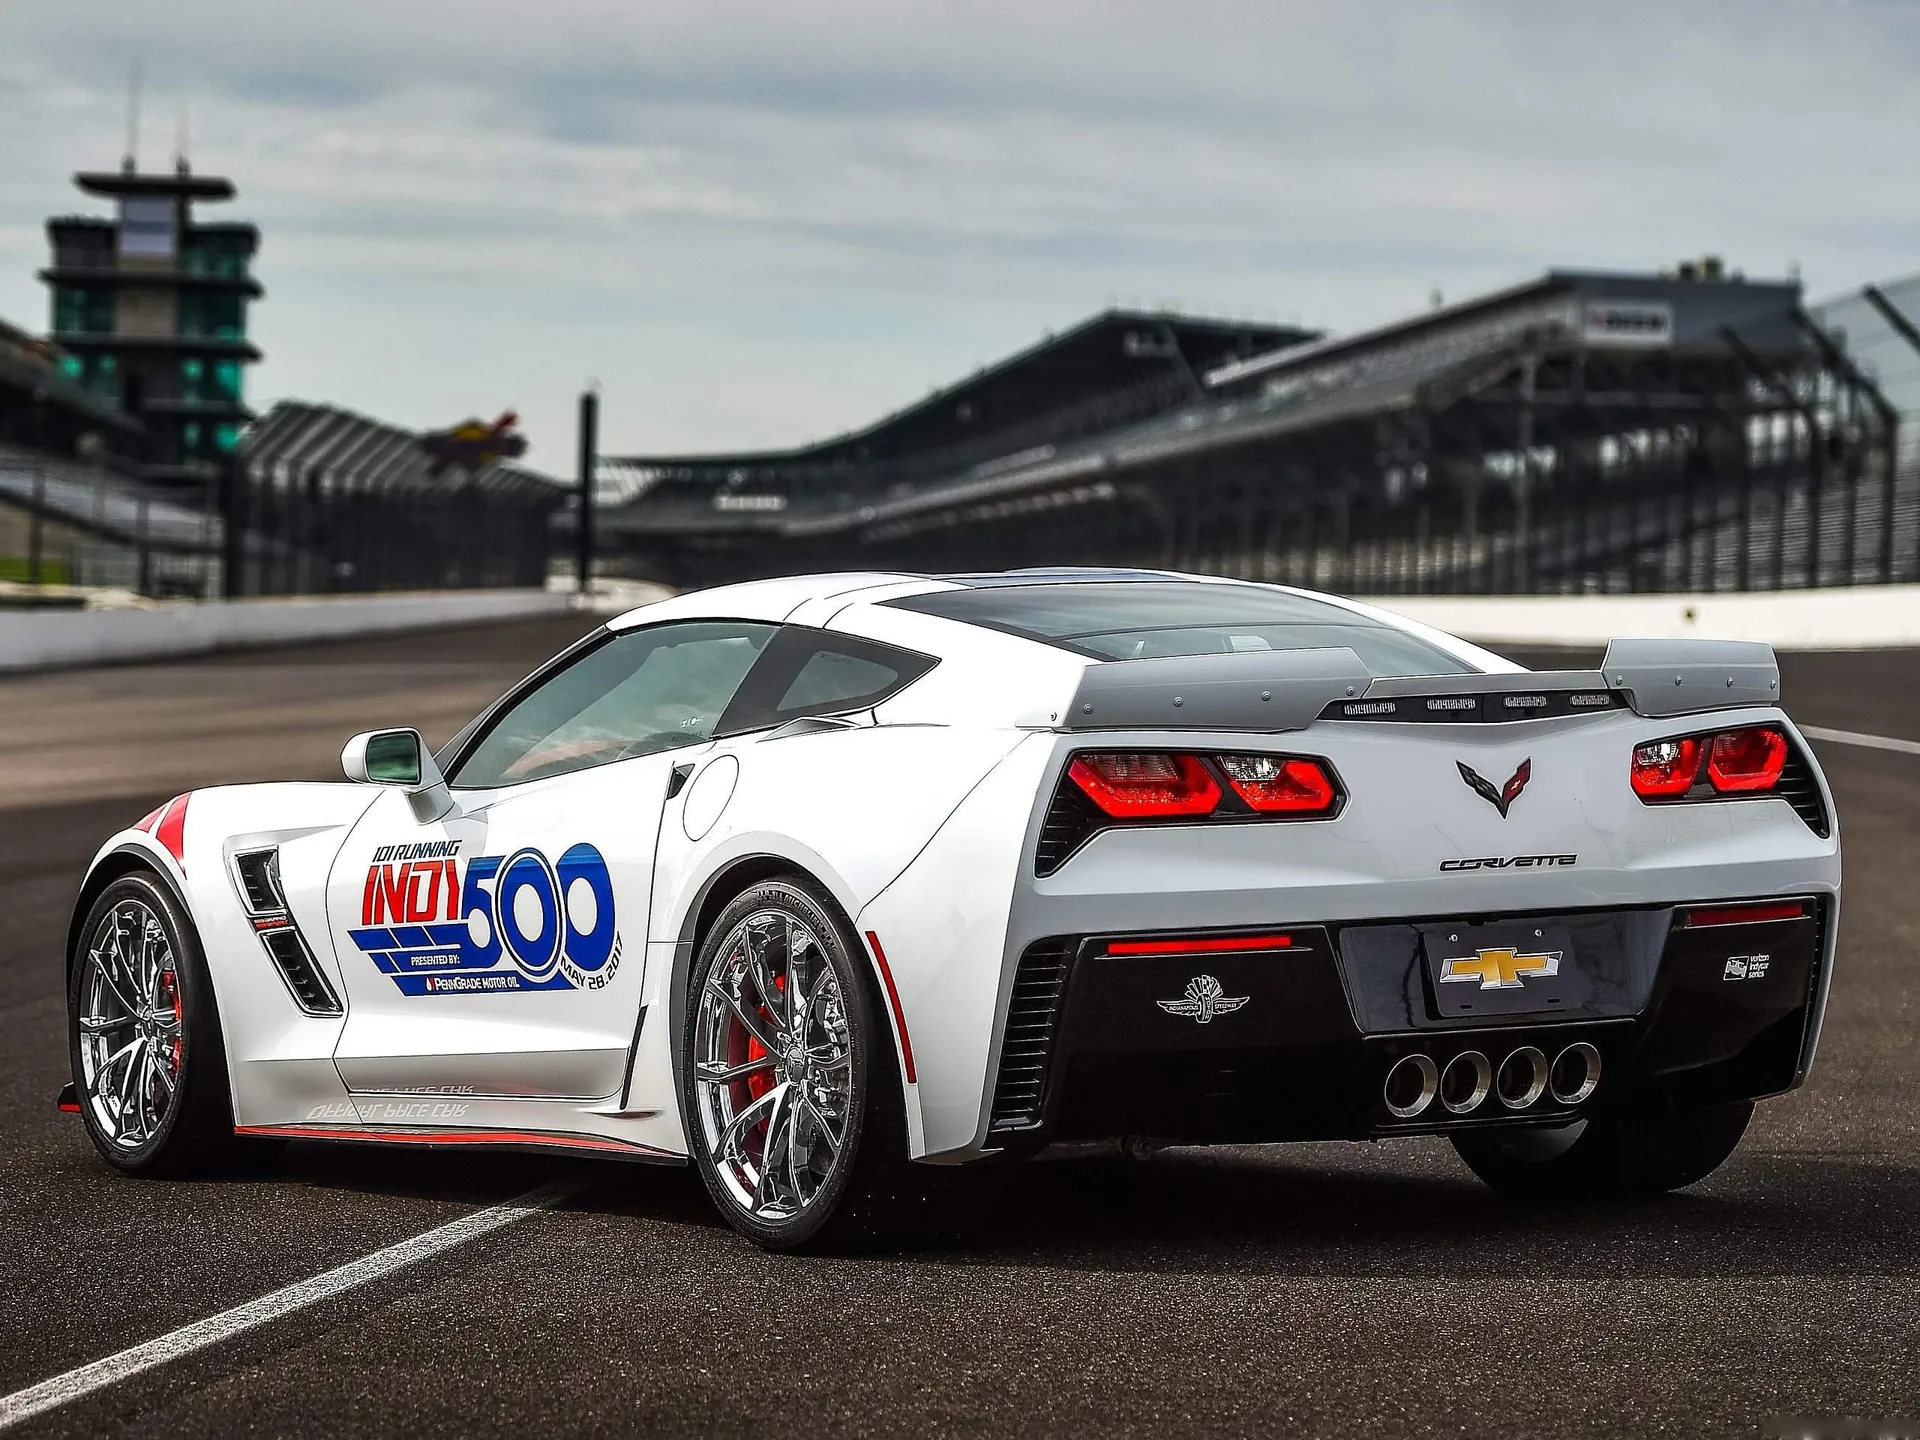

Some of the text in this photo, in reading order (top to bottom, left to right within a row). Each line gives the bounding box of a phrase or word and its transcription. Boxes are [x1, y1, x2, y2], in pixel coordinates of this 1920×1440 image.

[392, 839, 463, 862] RUNNING
[1439, 854, 1577, 872] CORVETTE
[362, 842, 616, 976] INDY 500
[410, 954, 461, 966] PRESENTED BY:
[560, 955, 586, 987] MAY
[482, 977, 507, 989] MOTOR
[507, 976, 520, 988] OIL
